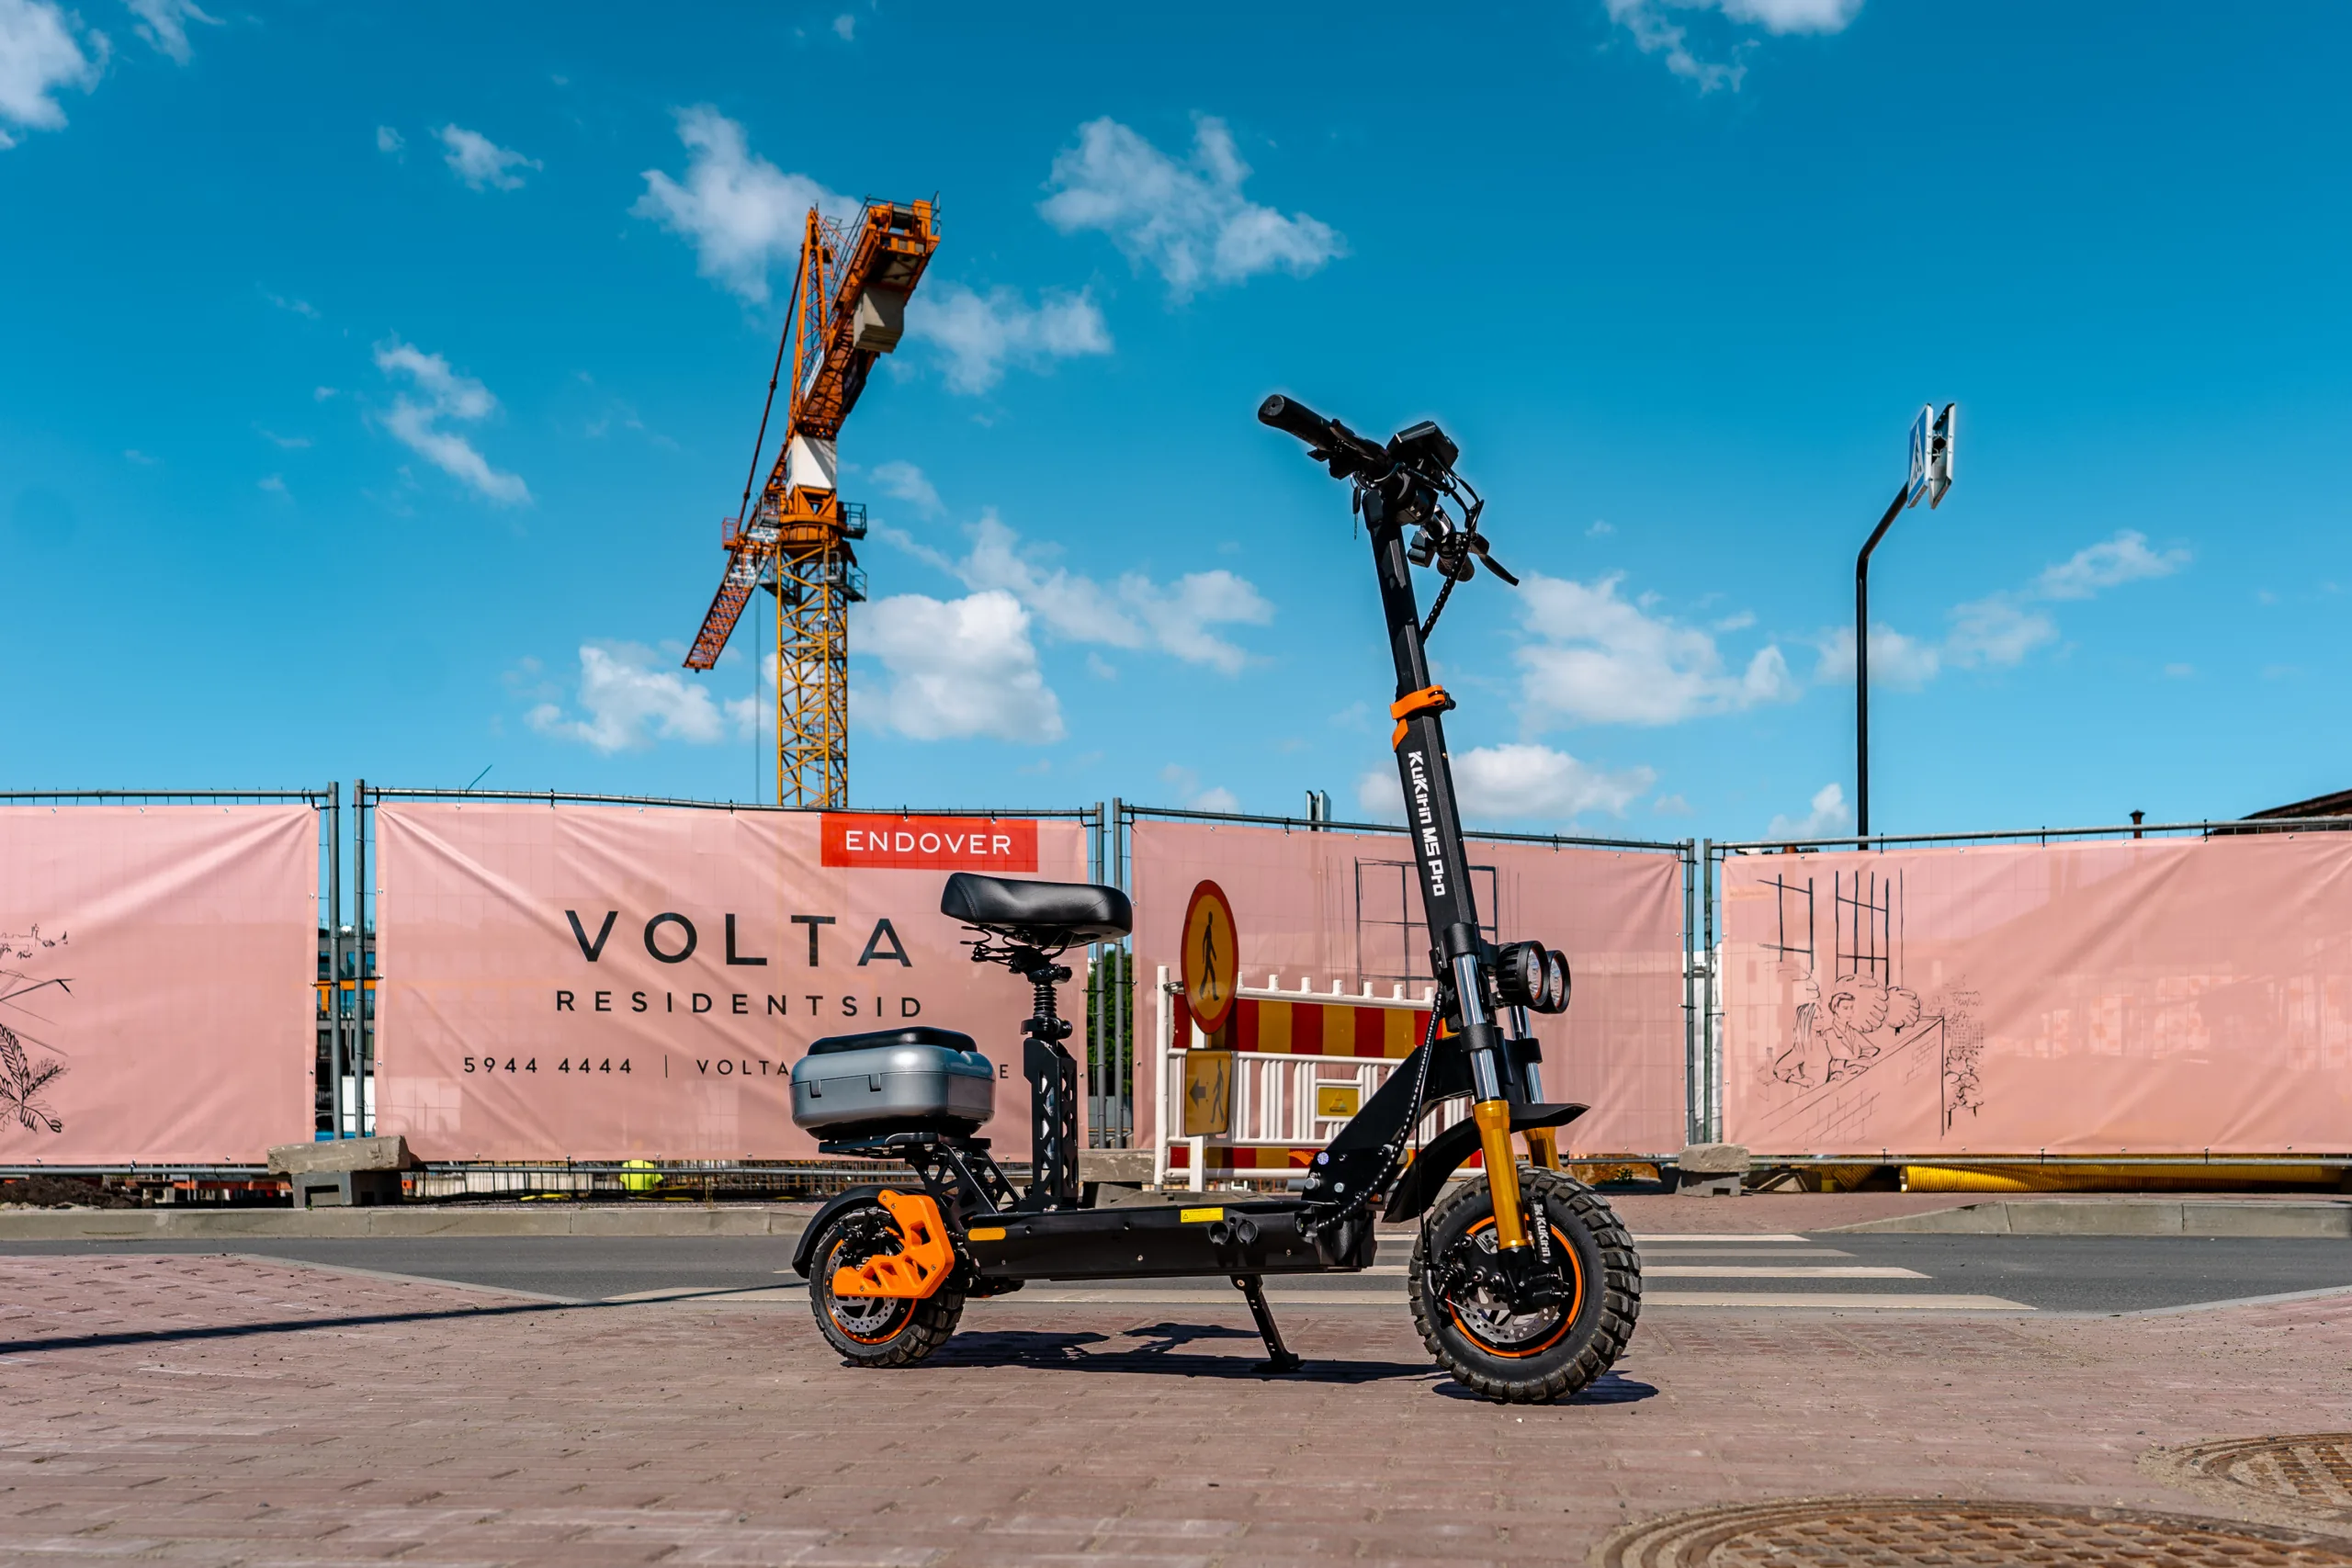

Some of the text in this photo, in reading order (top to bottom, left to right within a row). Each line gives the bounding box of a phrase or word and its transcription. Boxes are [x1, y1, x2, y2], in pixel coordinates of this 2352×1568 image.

[1408, 750, 1432, 825] KuKirin
[1428, 859, 1446, 897] Pro
[845, 829, 1012, 855] ENDOVER
[564, 909, 913, 968] VOLTA
[556, 990, 922, 1018] RESIDENTSID
[463, 1056, 538, 1074] 5944
[558, 1057, 632, 1075] 4444
